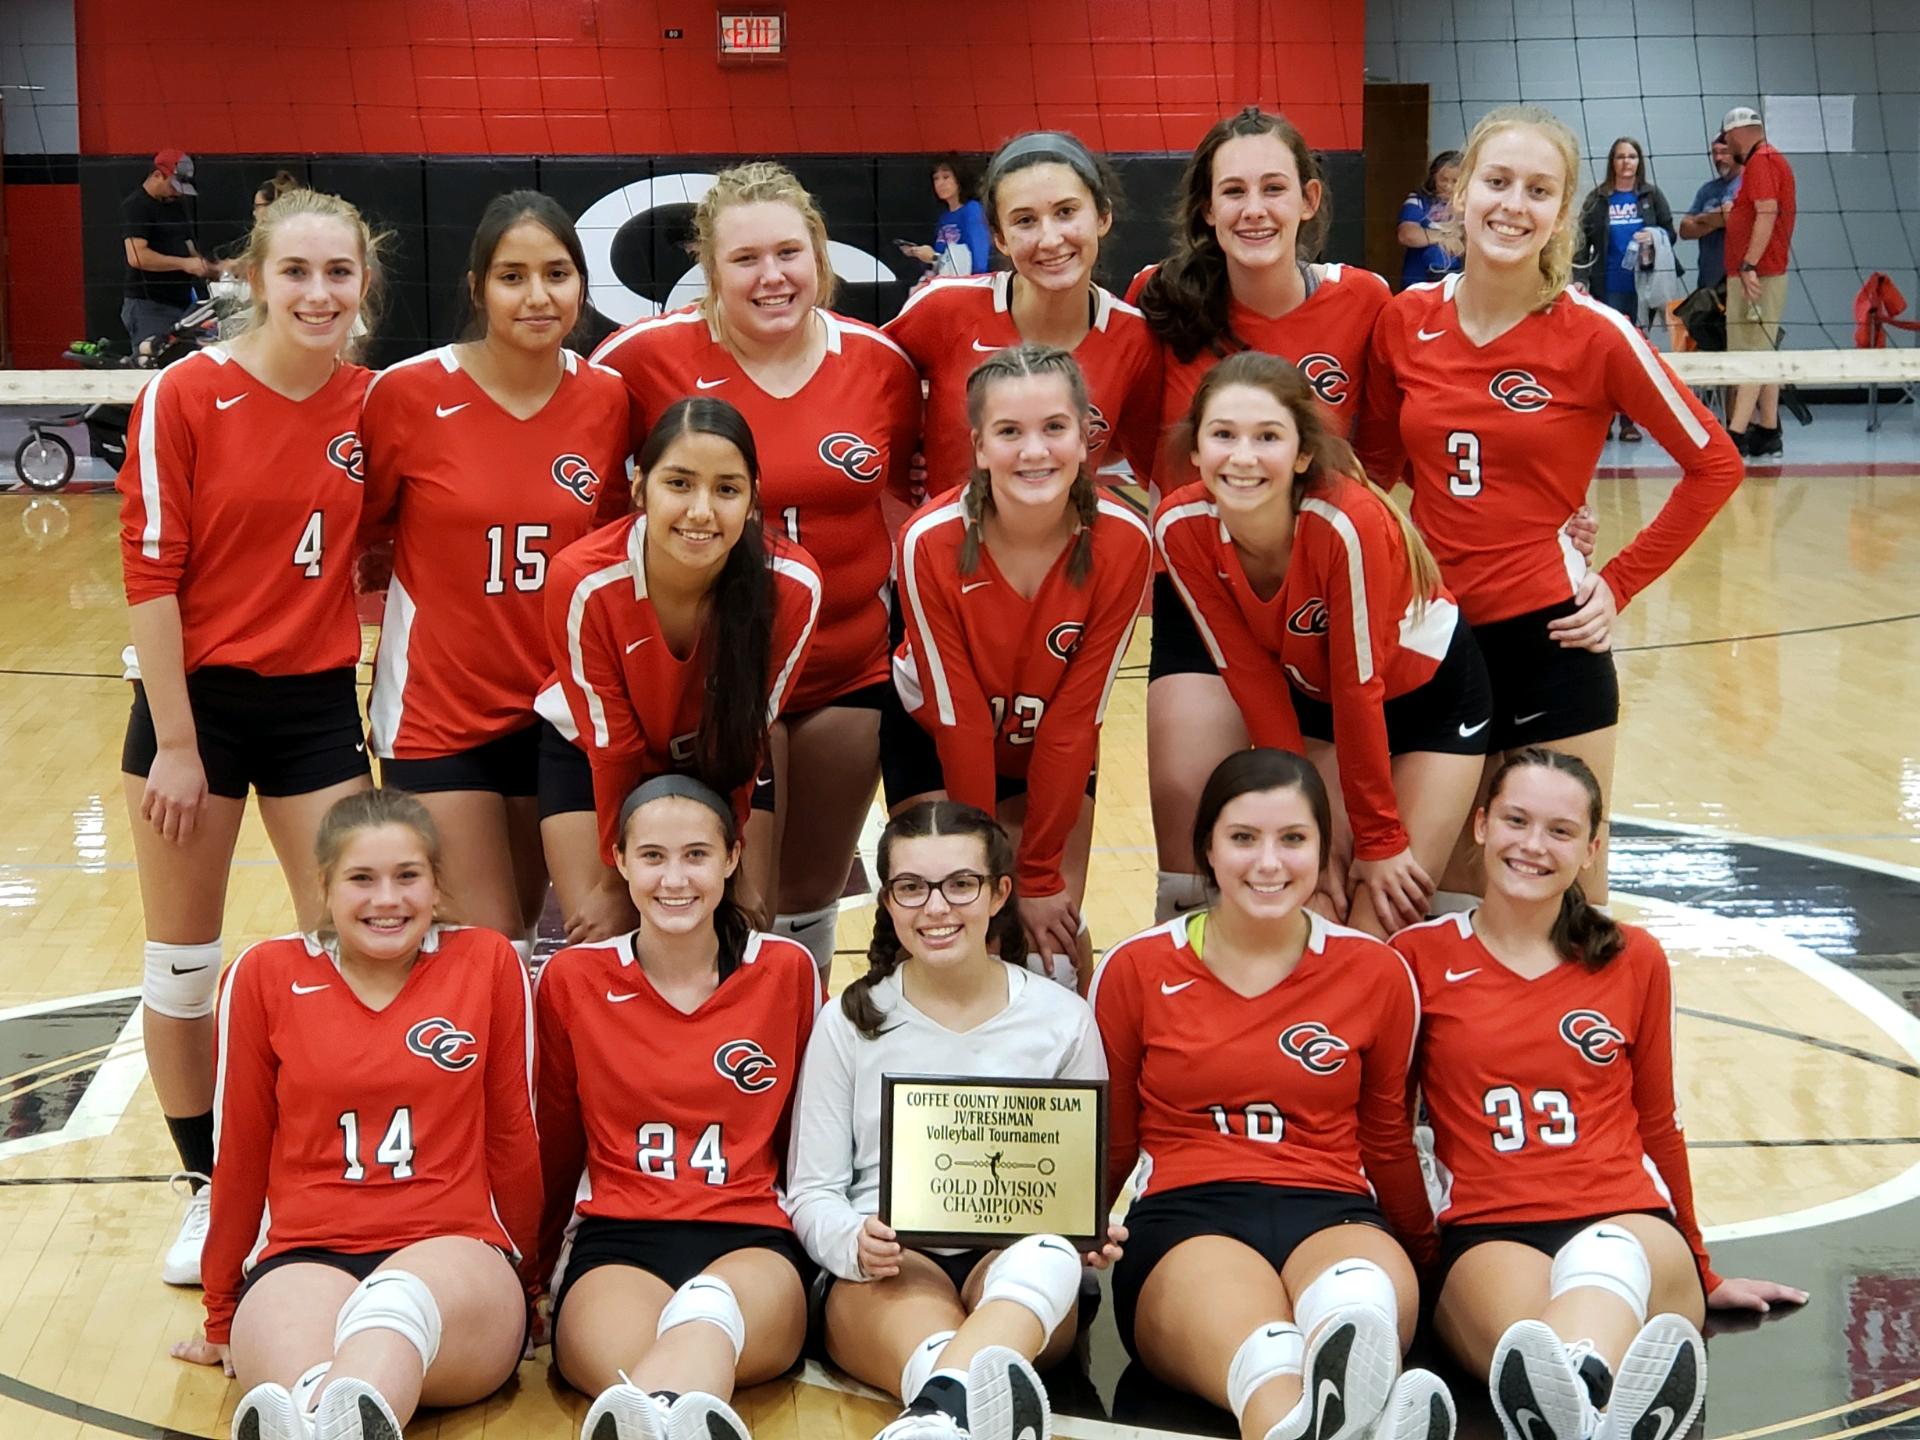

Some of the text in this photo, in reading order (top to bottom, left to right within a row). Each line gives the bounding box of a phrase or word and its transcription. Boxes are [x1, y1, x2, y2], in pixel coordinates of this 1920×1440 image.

[733, 18, 771, 49] EXIT
[1296, 353, 1350, 404] CC
[1488, 369, 1553, 412] CC
[551, 453, 600, 506] CC
[818, 432, 883, 483] CC
[1446, 431, 1482, 497] 3
[293, 510, 323, 578] 4
[485, 524, 550, 595] 15
[406, 1016, 478, 1072] CC
[1278, 1021, 1350, 1075] CC
[1559, 1009, 1625, 1066] CC
[714, 1039, 777, 1094] CC
[907, 1092, 1082, 1112] COFFEE COUNTY JUNIOR SLAM
[953, 1110, 1034, 1127] JV/FRESHMAN
[1484, 1085, 1577, 1152] 33
[338, 1106, 415, 1181] 14
[637, 1122, 728, 1185] 24
[927, 1125, 1060, 1144] Volleyball Tournament
[930, 1177, 1057, 1198] GOLD DIVISION
[943, 1196, 1044, 1216] CHAMPIONS
[974, 1214, 1013, 1224] 2019
